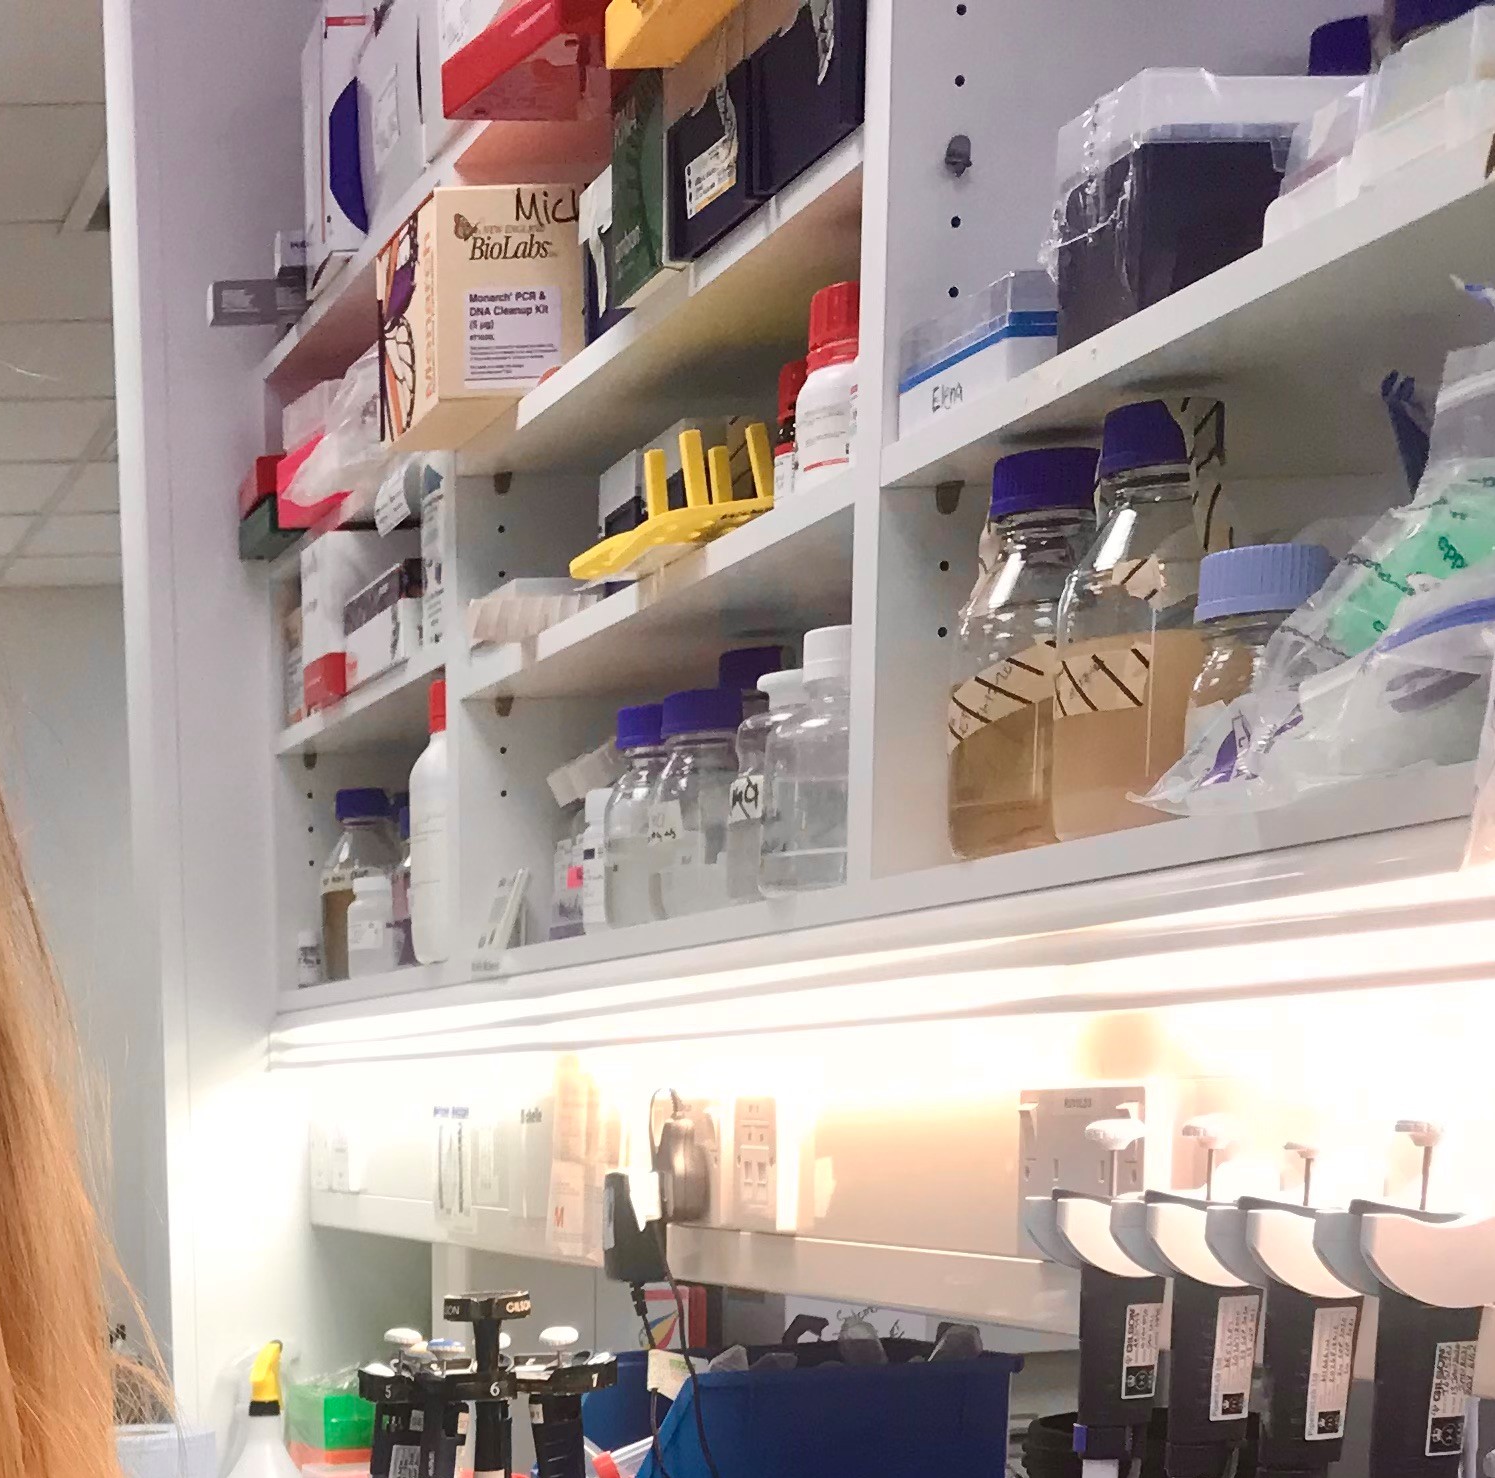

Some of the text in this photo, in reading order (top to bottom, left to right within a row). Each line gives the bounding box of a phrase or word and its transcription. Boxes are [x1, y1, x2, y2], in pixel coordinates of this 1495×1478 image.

[469, 234, 552, 260] BioLabs
[469, 304, 549, 316] DNA Cleanup Kit
[385, 1385, 392, 1398] 5
[490, 1382, 500, 1397] 6
